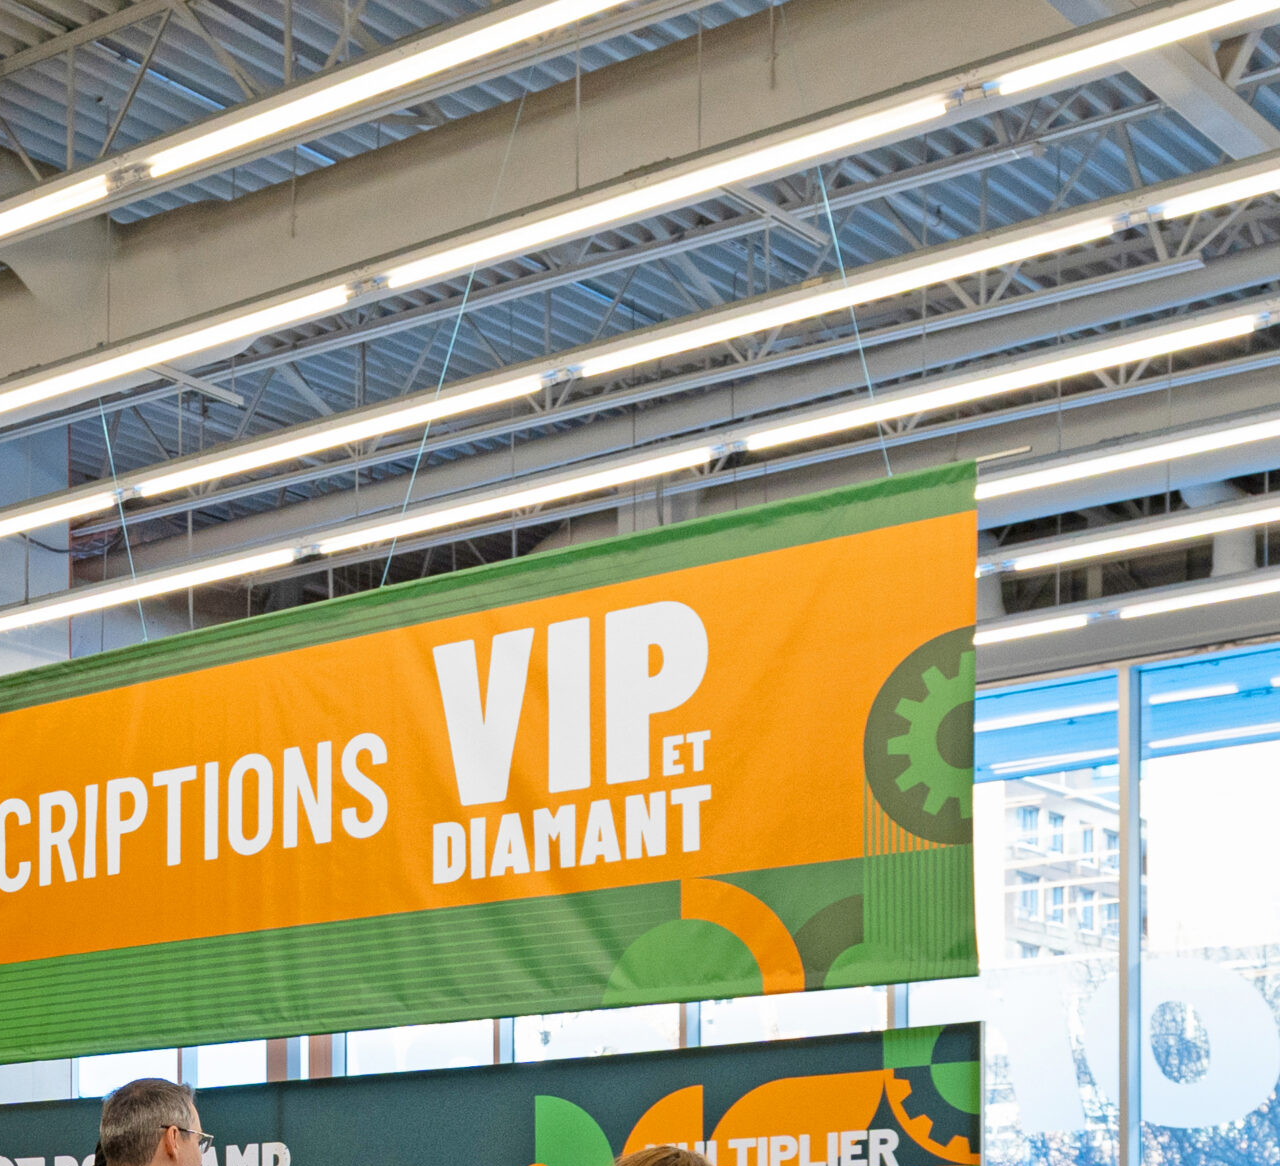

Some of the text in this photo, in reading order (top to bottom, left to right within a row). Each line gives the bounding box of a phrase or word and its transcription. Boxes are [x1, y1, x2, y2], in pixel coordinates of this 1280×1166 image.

[432, 599, 709, 807] VIP
[662, 729, 712, 777] ET
[432, 784, 712, 885] DIAMANT
